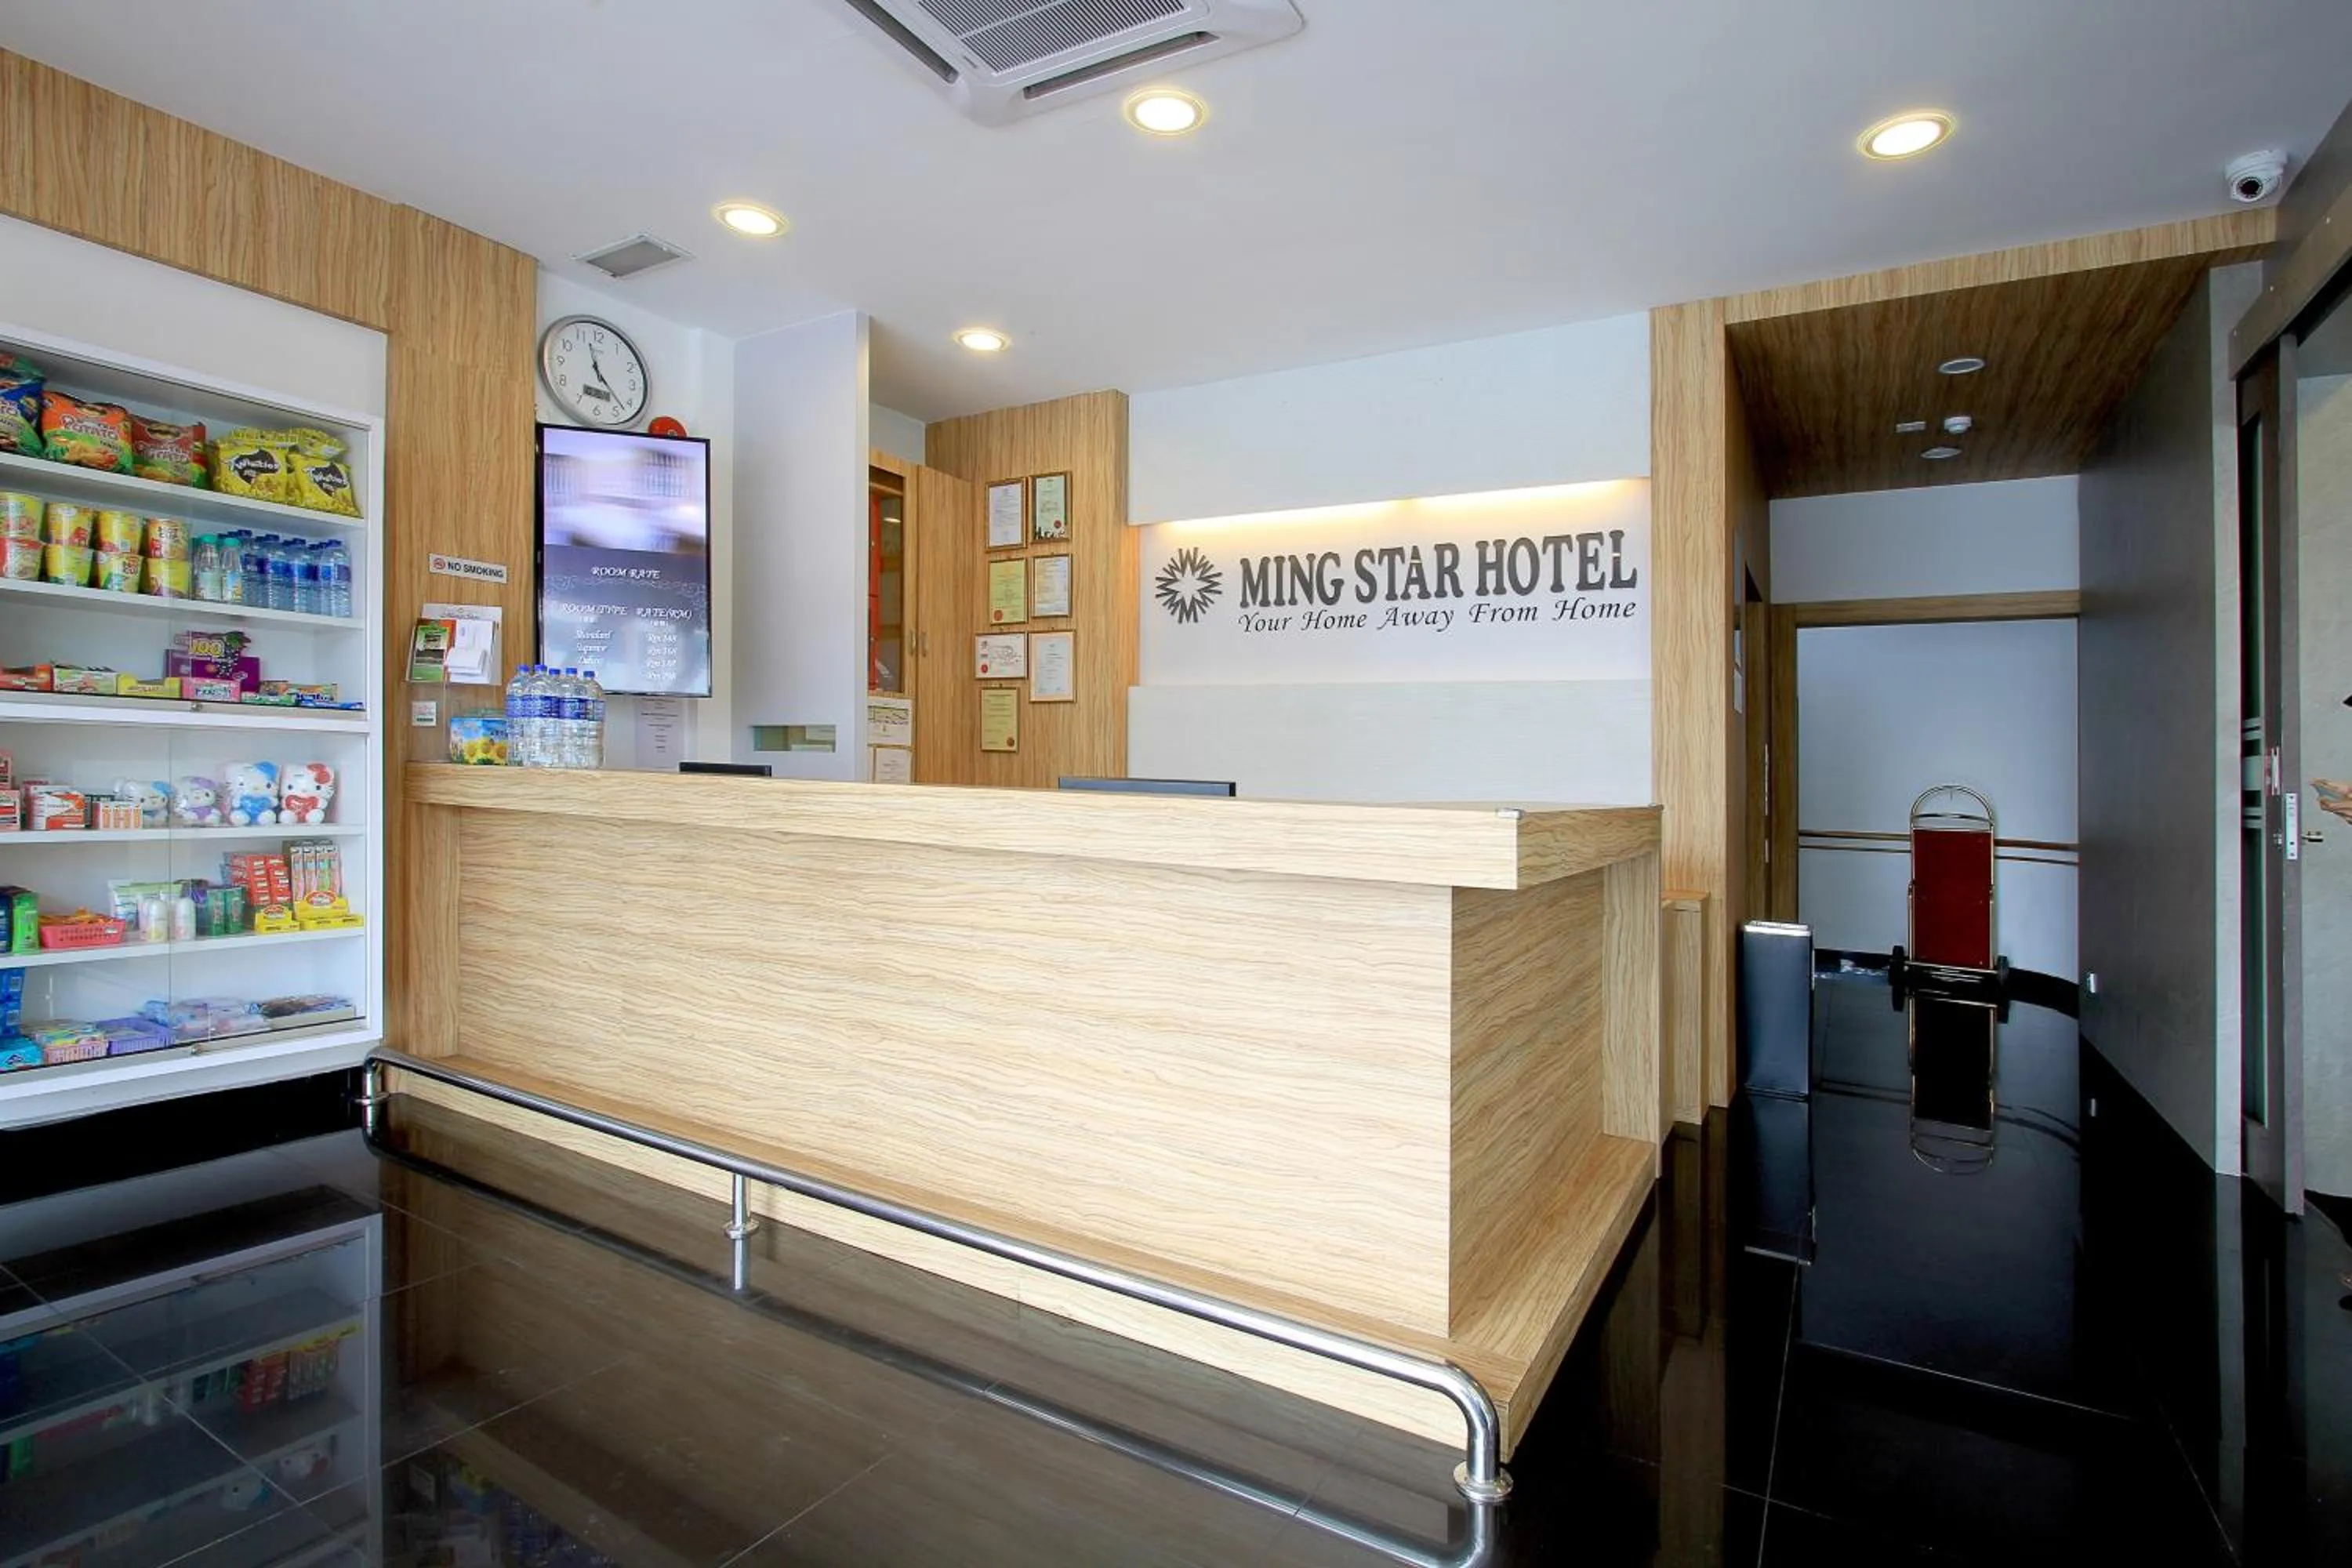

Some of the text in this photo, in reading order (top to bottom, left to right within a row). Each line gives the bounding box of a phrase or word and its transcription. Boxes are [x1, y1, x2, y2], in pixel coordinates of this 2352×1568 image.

[593, 329, 604, 344] 12
[561, 338, 573, 352] 10
[615, 342, 619, 356] 1
[556, 355, 565, 367] 9
[626, 361, 634, 374] 2
[559, 374, 567, 387] 8
[628, 378, 637, 391] 3
[575, 391, 583, 405] 7
[626, 397, 633, 409] 4
[591, 405, 601, 416] 6
[612, 405, 621, 418] 5
[447, 561, 504, 579] NO SMOKING
[590, 566, 661, 580] ROOM RATE
[1239, 529, 1638, 609] MING STAR HOTEL
[1238, 597, 1637, 633] Your Home Away From Home
